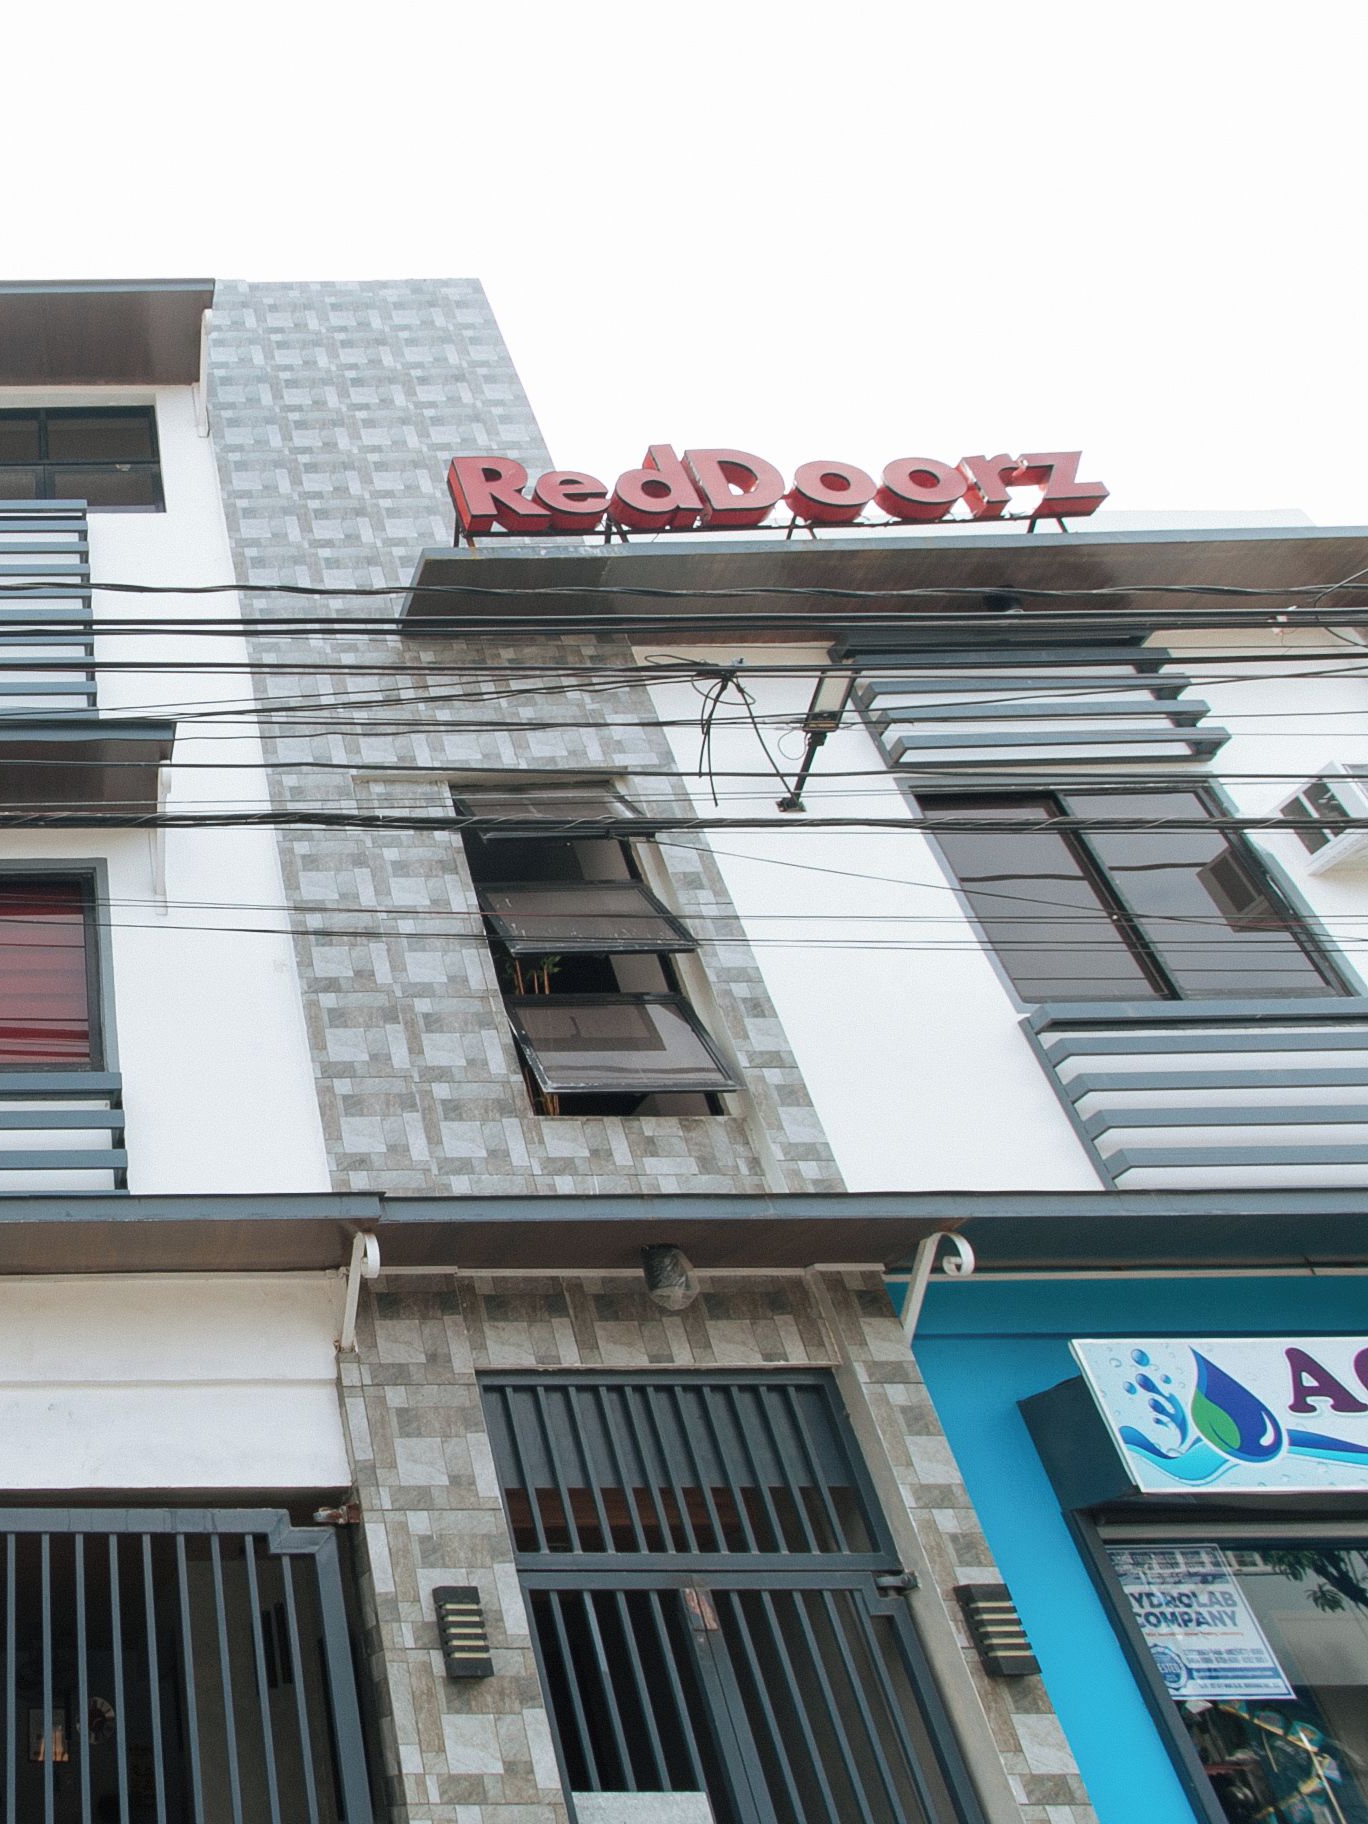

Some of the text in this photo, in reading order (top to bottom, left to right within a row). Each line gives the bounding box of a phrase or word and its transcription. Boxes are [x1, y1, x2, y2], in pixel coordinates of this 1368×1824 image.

[447, 443, 1109, 533] RedDoorz
[1284, 1347, 1368, 1414] A
[1129, 1591, 1237, 1609] YDROLAB
